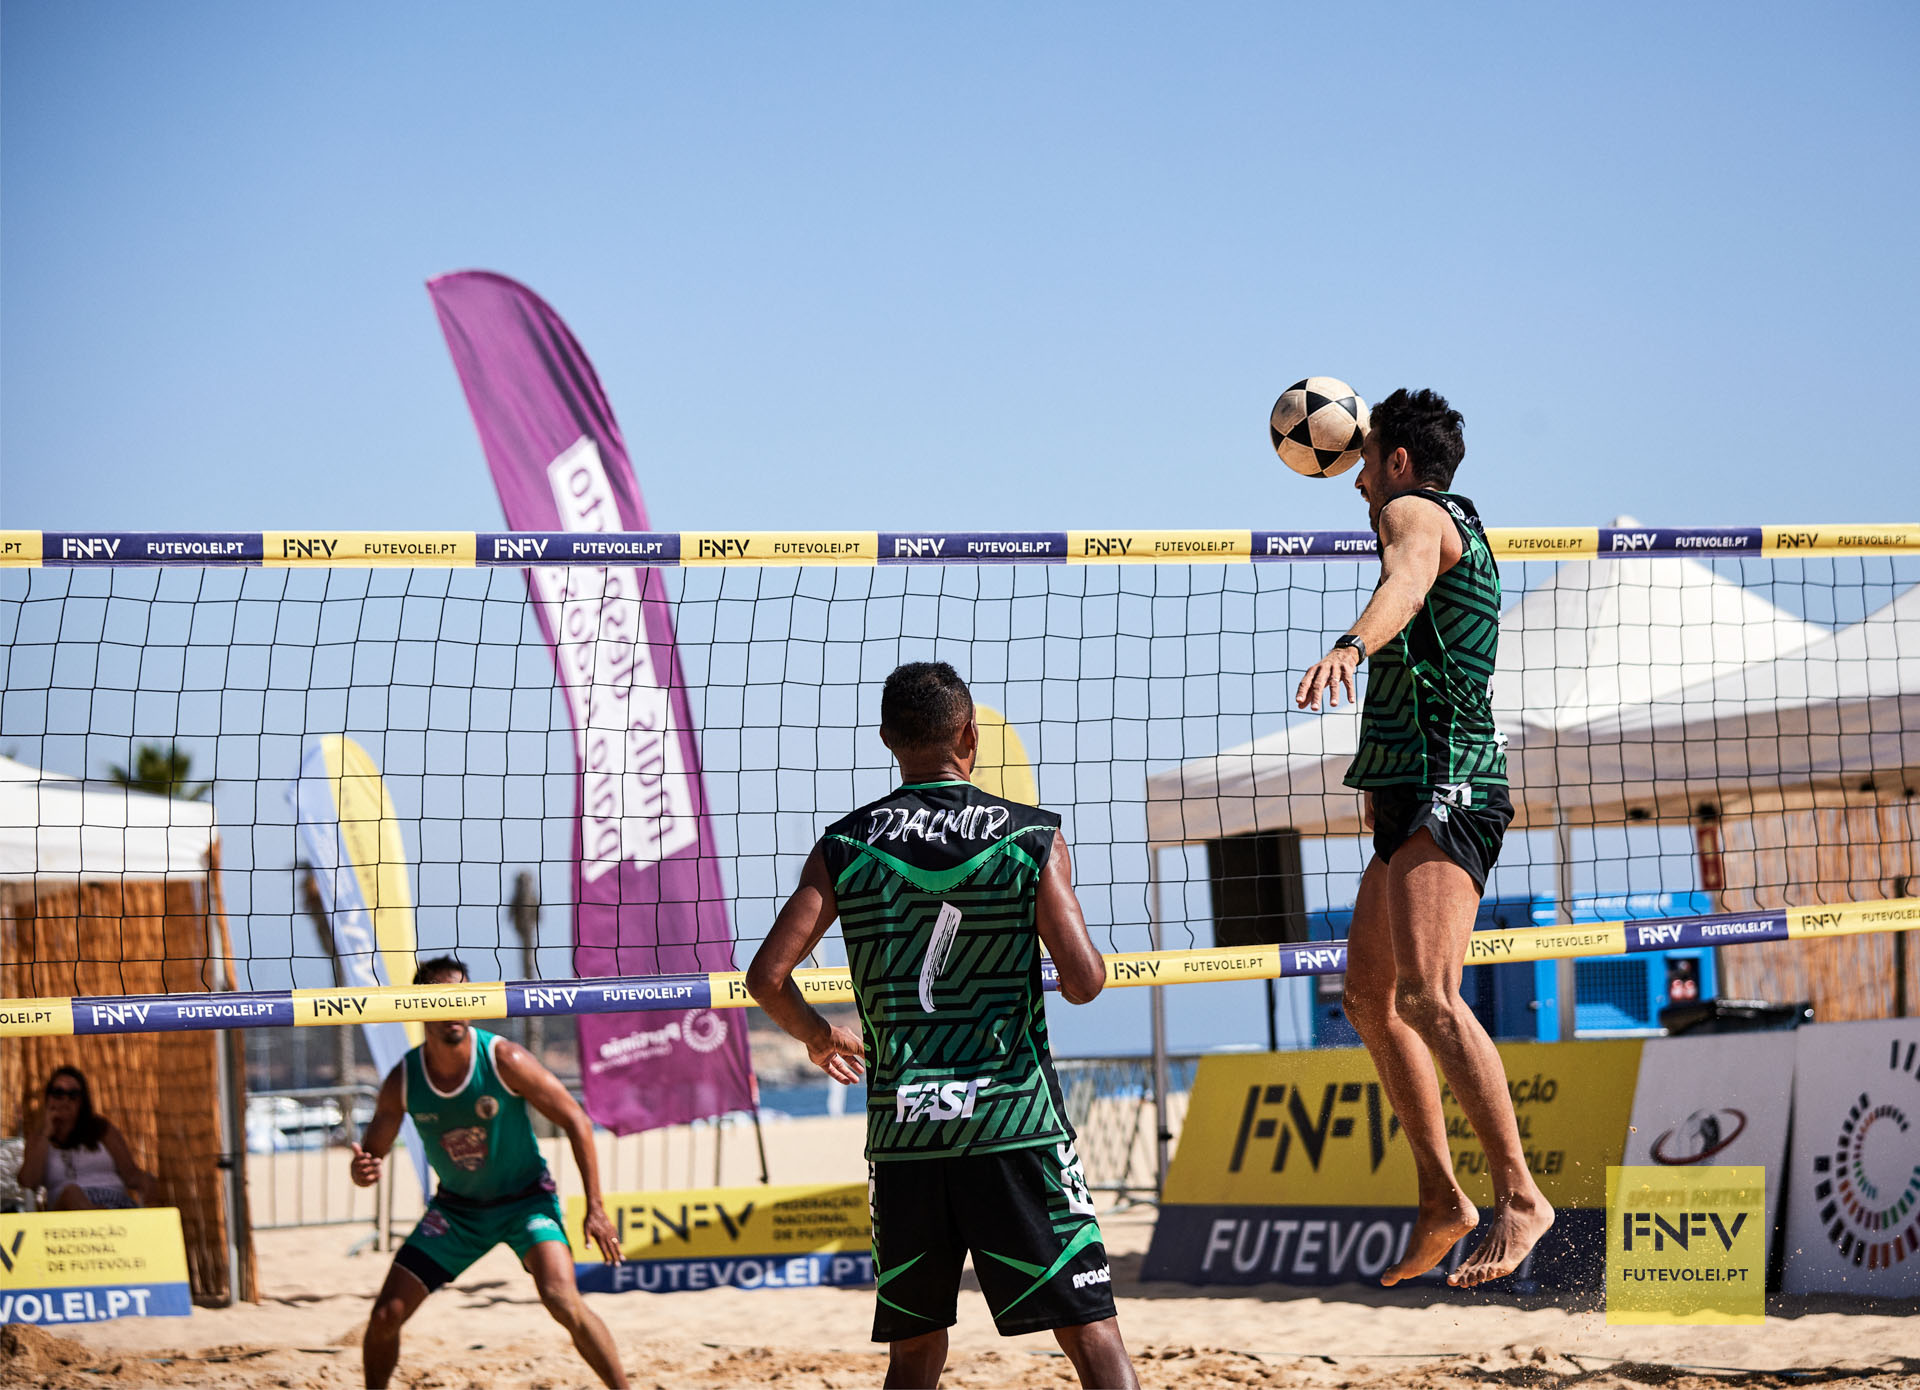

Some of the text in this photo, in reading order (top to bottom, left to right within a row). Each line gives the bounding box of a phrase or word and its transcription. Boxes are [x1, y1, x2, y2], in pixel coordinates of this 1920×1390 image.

[63, 538, 244, 560] FNFV FUTEVOLEI.PT
[284, 539, 456, 559] FNFV FUTEVOLEI.PT
[494, 538, 662, 560] FNFV FUTEVOLEI.PT
[699, 539, 860, 558] FNFV FUTEVOLEI.PT
[895, 538, 1051, 558] FNFV FUTEVOLEI.PT
[1085, 538, 1235, 556] FNFV FUTEVOLEI.PT
[1267, 537, 1314, 555] FNFV
[1509, 538, 1583, 550] FUTEVOLEI.PT
[1612, 533, 1749, 552] FNFV FUTEVOLEI.PT
[1777, 533, 1908, 549] FNFV FUTEVOLEI.PT
[867, 804, 1009, 846] DJALMIR
[1802, 912, 1842, 931] FNFV
[1638, 921, 1773, 945] FNFV FUTEVOLEI.PT
[1471, 934, 1609, 958] FNFV FUTEVOLEI.PT
[1115, 957, 1263, 980] FNFV FUTEVOLEI.PT
[1295, 949, 1342, 969] FNFV
[314, 995, 487, 1018] FNFV FUTEVOLEI.PT
[525, 986, 693, 1009] FNFV FUTEVOLEI.PT
[92, 1002, 274, 1026] FNFV FUTEVOLEI.PT
[895, 1077, 993, 1123] FAST
[44, 1225, 128, 1240] FEDERAÇÃO
[617, 1201, 755, 1245] FNFV
[46, 1243, 116, 1256] NACIONAL
[48, 1260, 65, 1272] DE
[613, 1257, 872, 1291] FUTEVOLEI.PT
